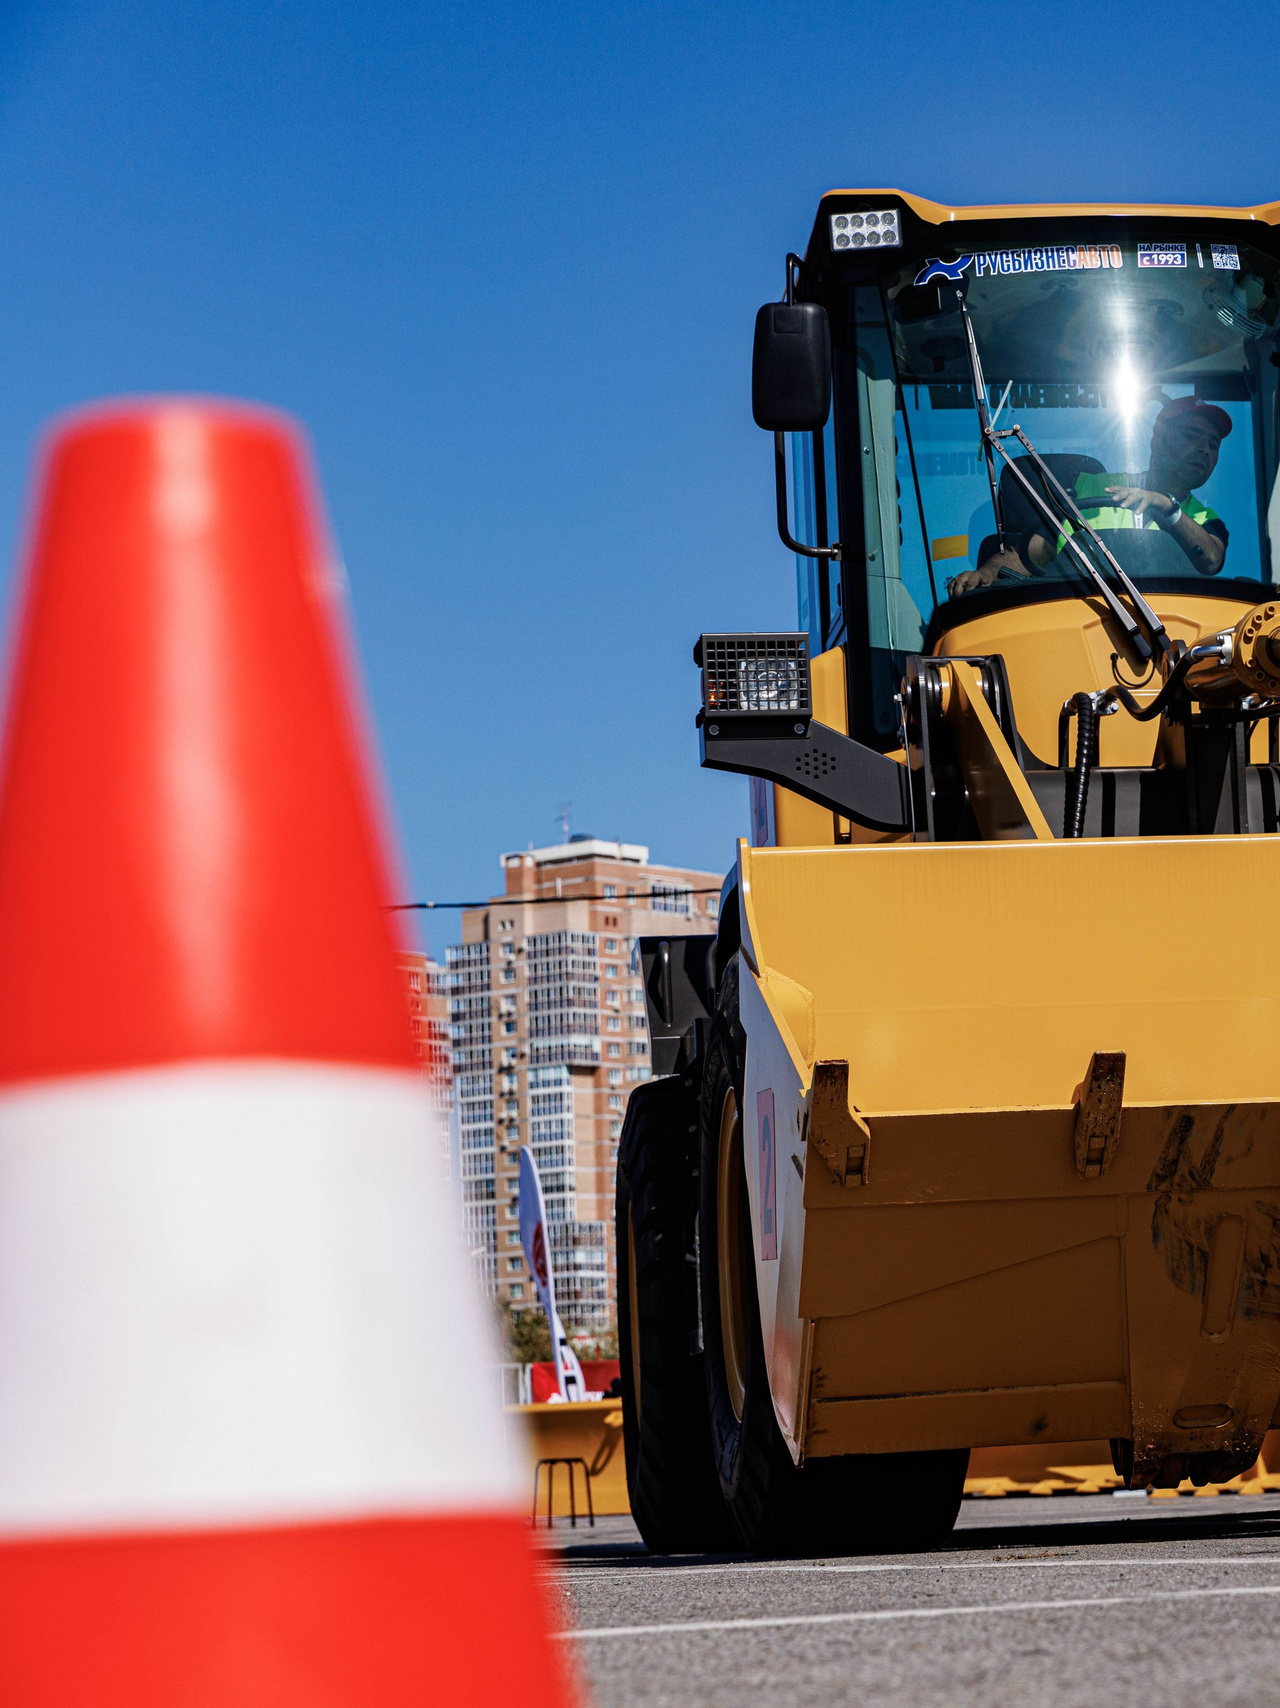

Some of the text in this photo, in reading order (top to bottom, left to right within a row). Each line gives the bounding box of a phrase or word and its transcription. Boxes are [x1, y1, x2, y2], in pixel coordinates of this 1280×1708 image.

[1139, 244, 1186, 252] НА РЫНКЕ
[1151, 253, 1182, 265] 1993
[975, 244, 1123, 276] РУСБИЗНЕСАВТО
[761, 1113, 773, 1235] 2
